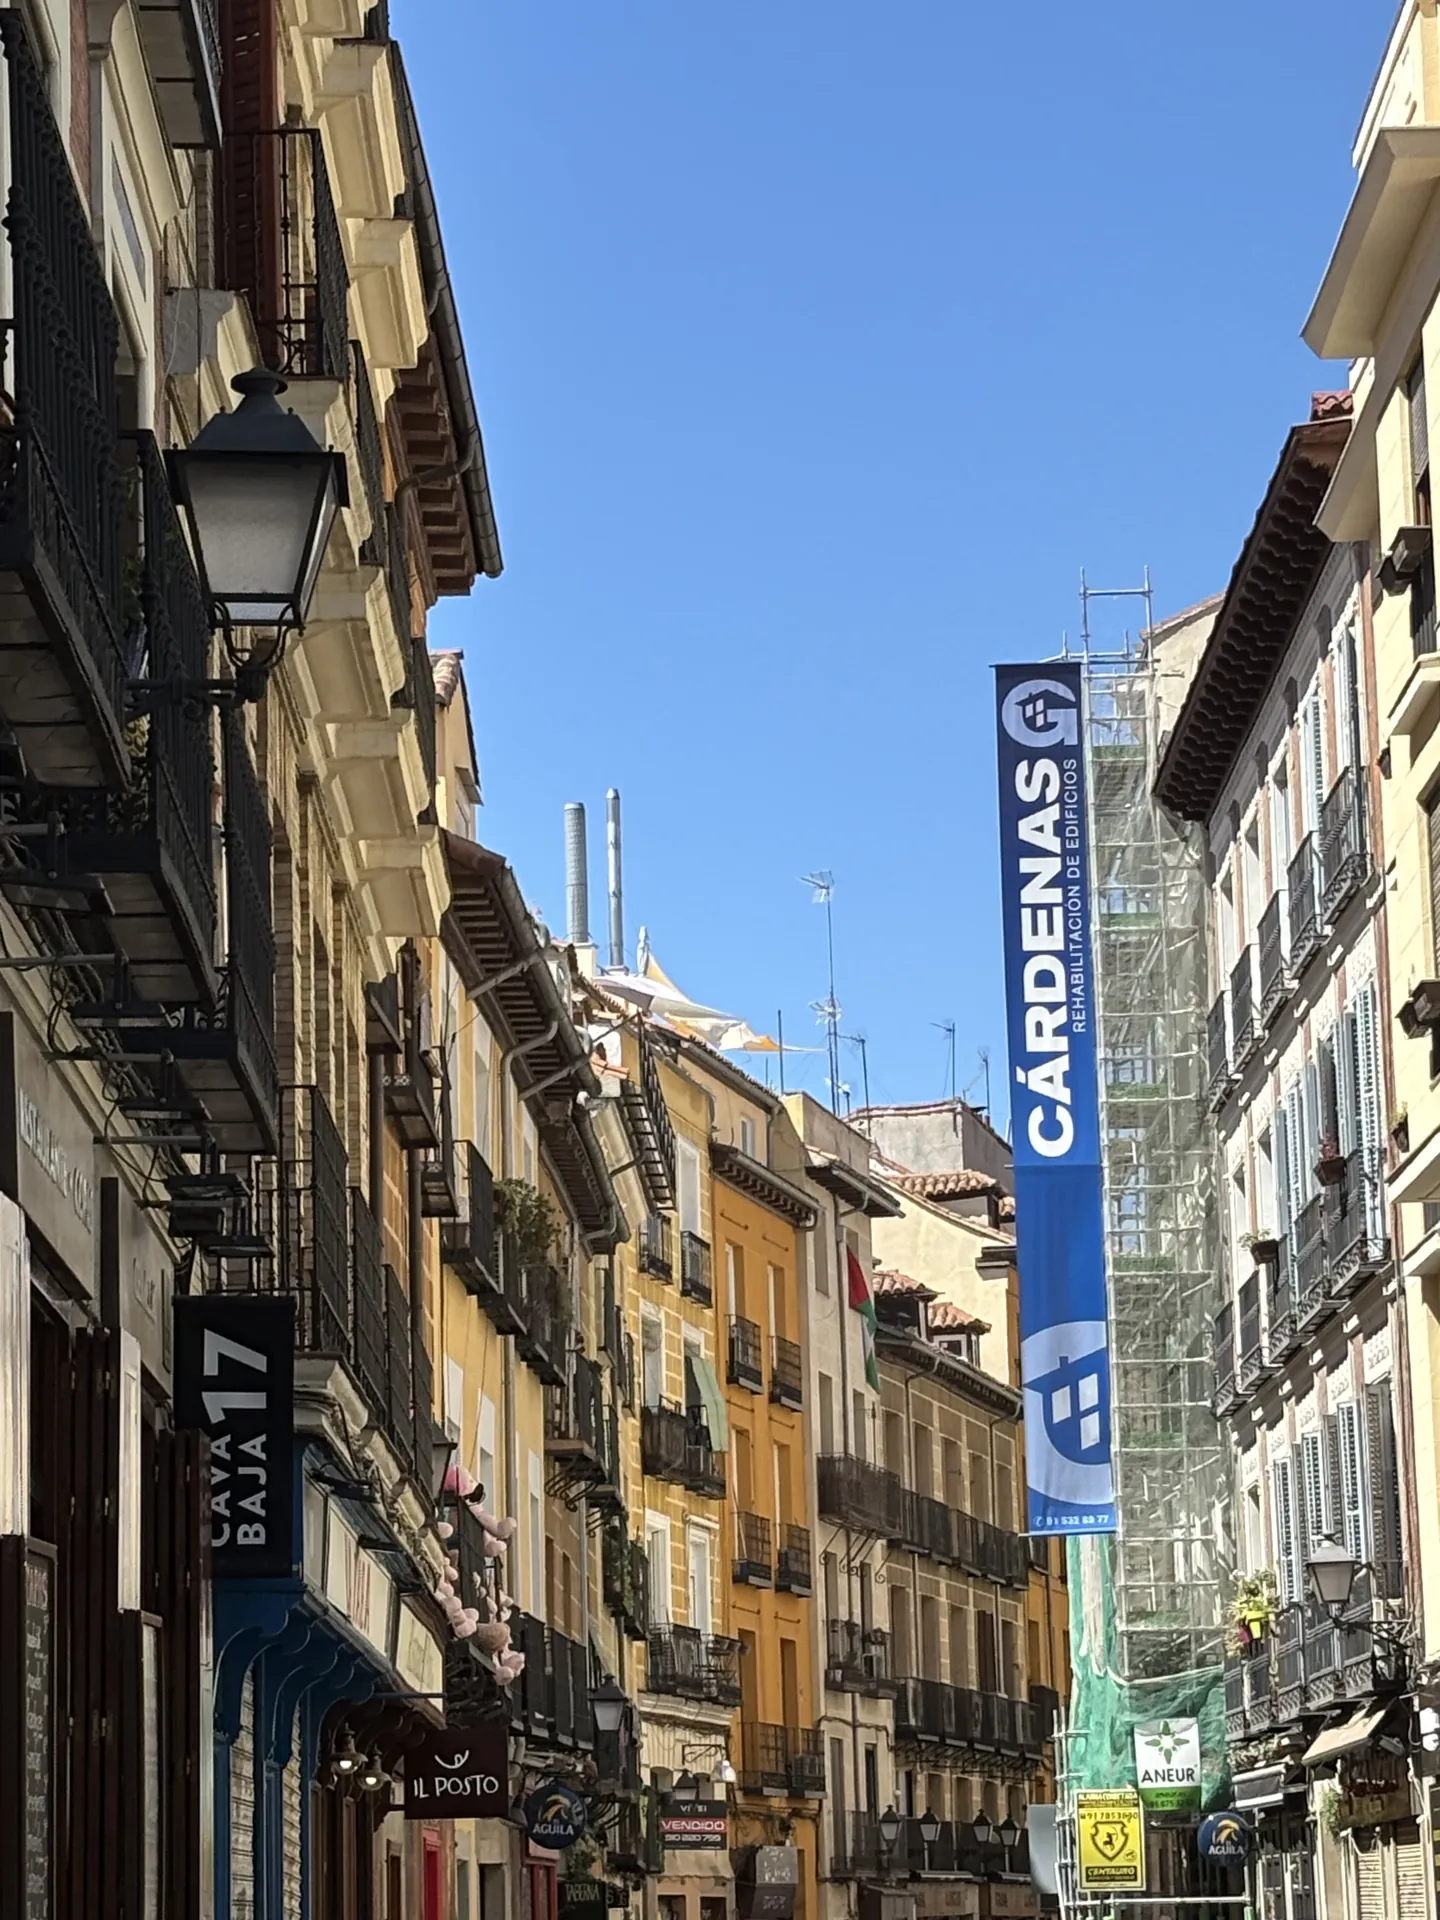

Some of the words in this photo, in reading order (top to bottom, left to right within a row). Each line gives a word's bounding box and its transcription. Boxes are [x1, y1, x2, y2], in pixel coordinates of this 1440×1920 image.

[1063, 759, 1080, 849] EDIFICIOS
[1066, 855, 1080, 878] DE
[1015, 758, 1074, 1157] CÁRDENAS
[1063, 886, 1086, 1033] REHABILITACIÓN
[202, 1328, 267, 1424] 17
[211, 1434, 231, 1547] CAVA
[237, 1433, 267, 1545] BAJA
[414, 1778, 429, 1798] IL
[435, 1774, 499, 1797] POSTO
[1141, 1767, 1195, 1783] ANEUR
[661, 1820, 725, 1830] VENDIDO
